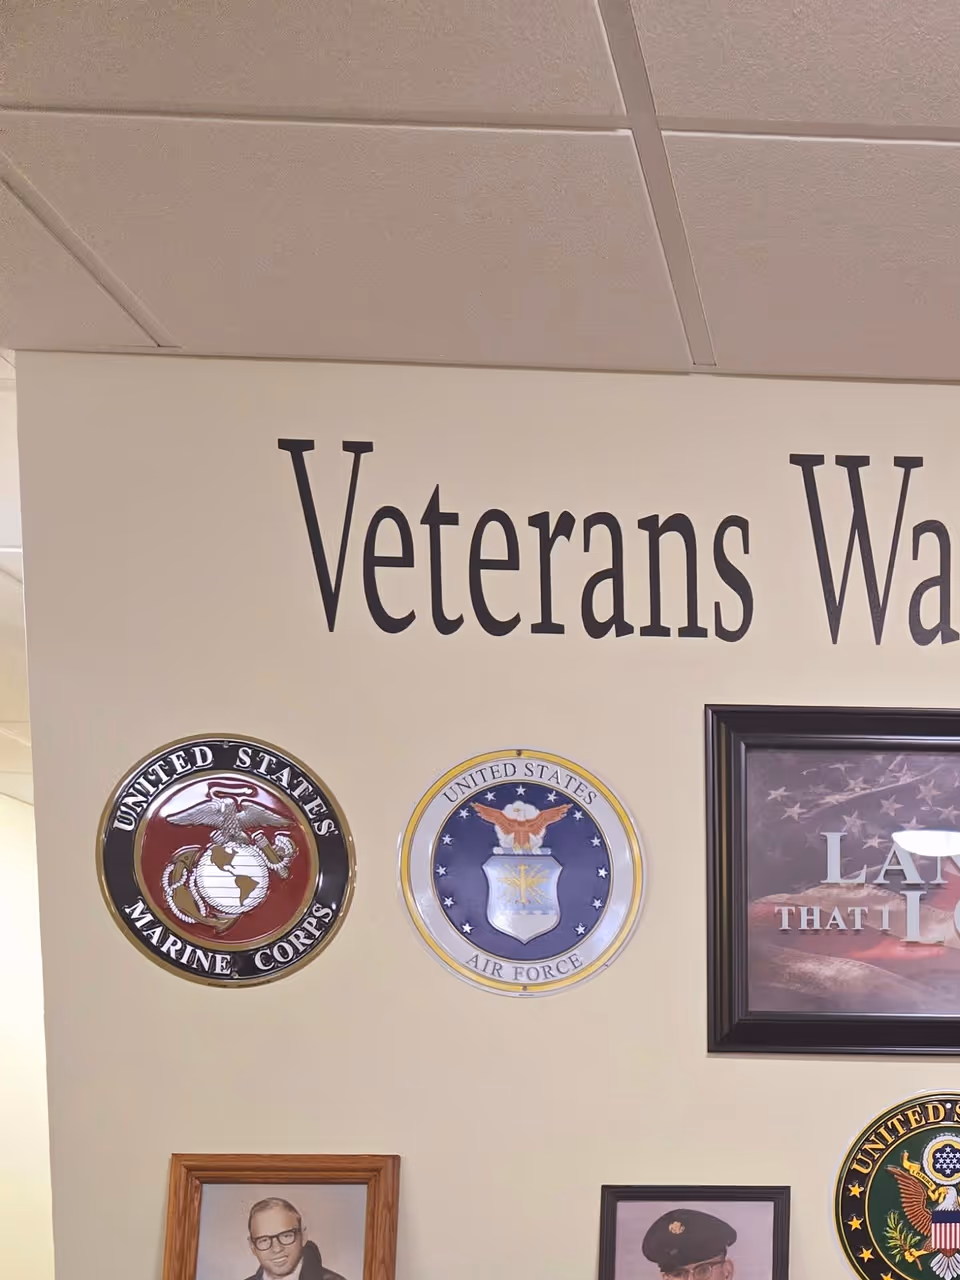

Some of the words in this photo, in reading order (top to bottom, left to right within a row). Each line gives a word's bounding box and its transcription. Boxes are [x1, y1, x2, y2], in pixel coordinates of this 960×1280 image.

[278, 438, 754, 643] Veterans
[112, 744, 214, 832] UNITED
[234, 746, 336, 837] STATES
[441, 762, 518, 805] UNITED
[523, 762, 599, 807] STATES
[124, 898, 232, 975] MARINE
[253, 902, 334, 971] CORPS
[775, 905, 868, 931] THAT
[879, 904, 892, 931] I
[465, 952, 505, 979] AIR
[512, 952, 584, 982] FORCE
[850, 1102, 946, 1175] UNITED
